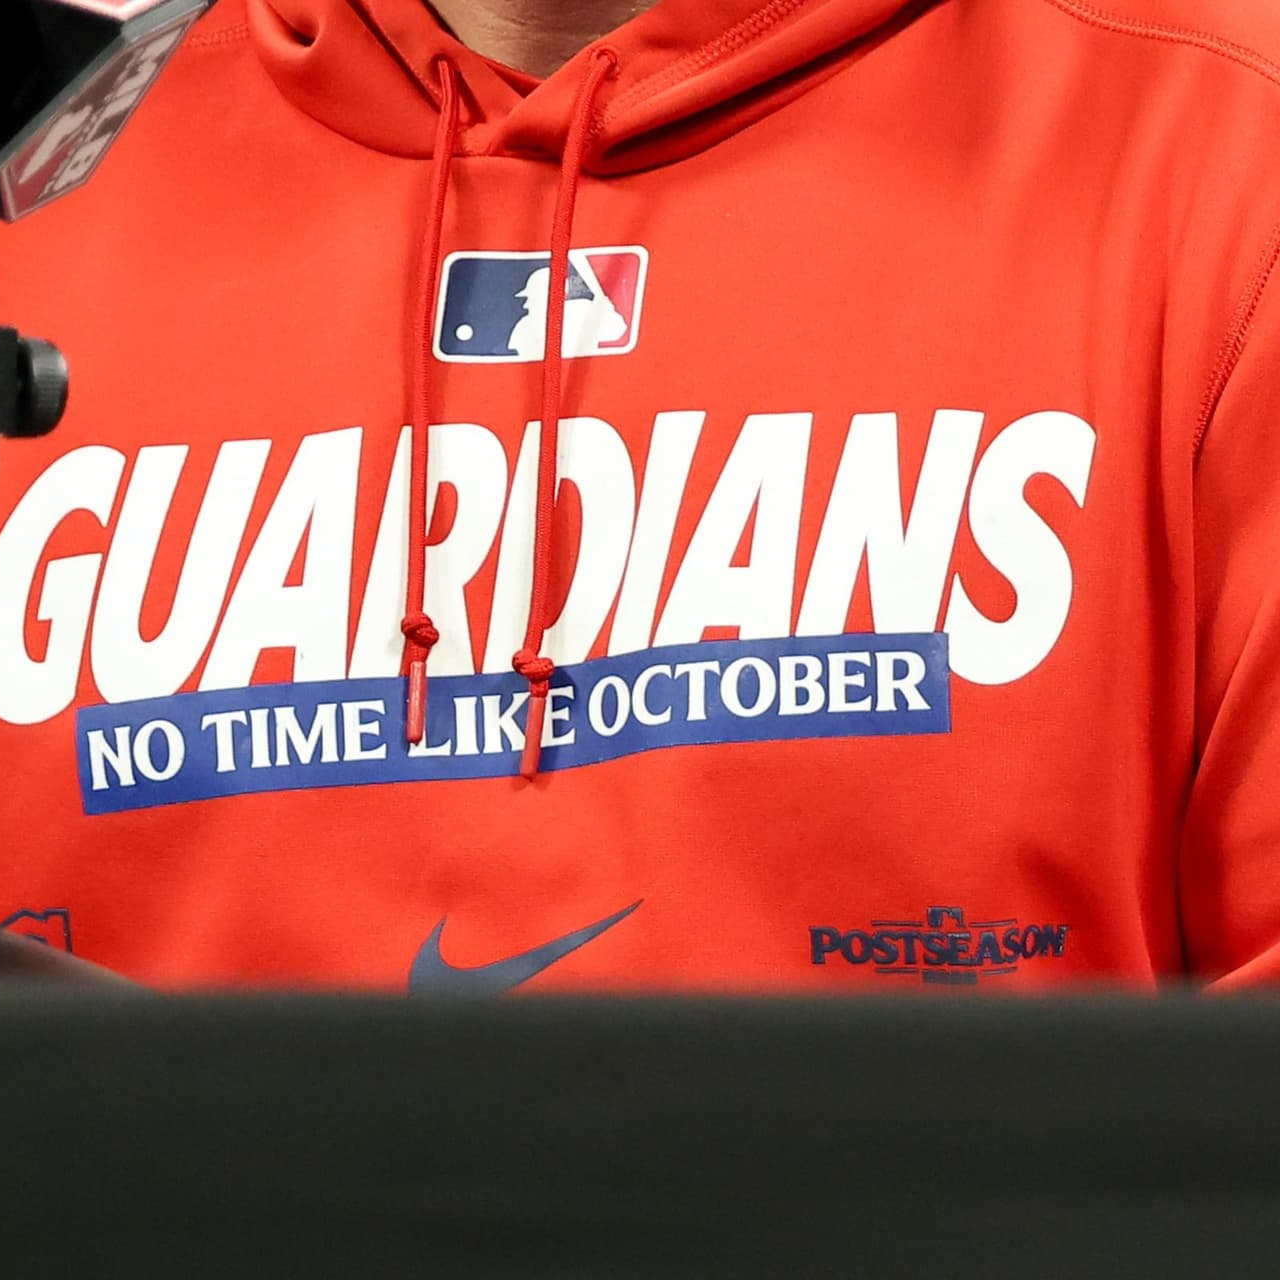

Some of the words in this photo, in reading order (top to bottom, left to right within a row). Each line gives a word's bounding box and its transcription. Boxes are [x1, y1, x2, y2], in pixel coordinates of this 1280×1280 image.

[86, 719, 187, 791] NO
[201, 700, 387, 773] TIME
[587, 650, 931, 738] OCTOBER
[809, 923, 1069, 966] POSTSEASON
